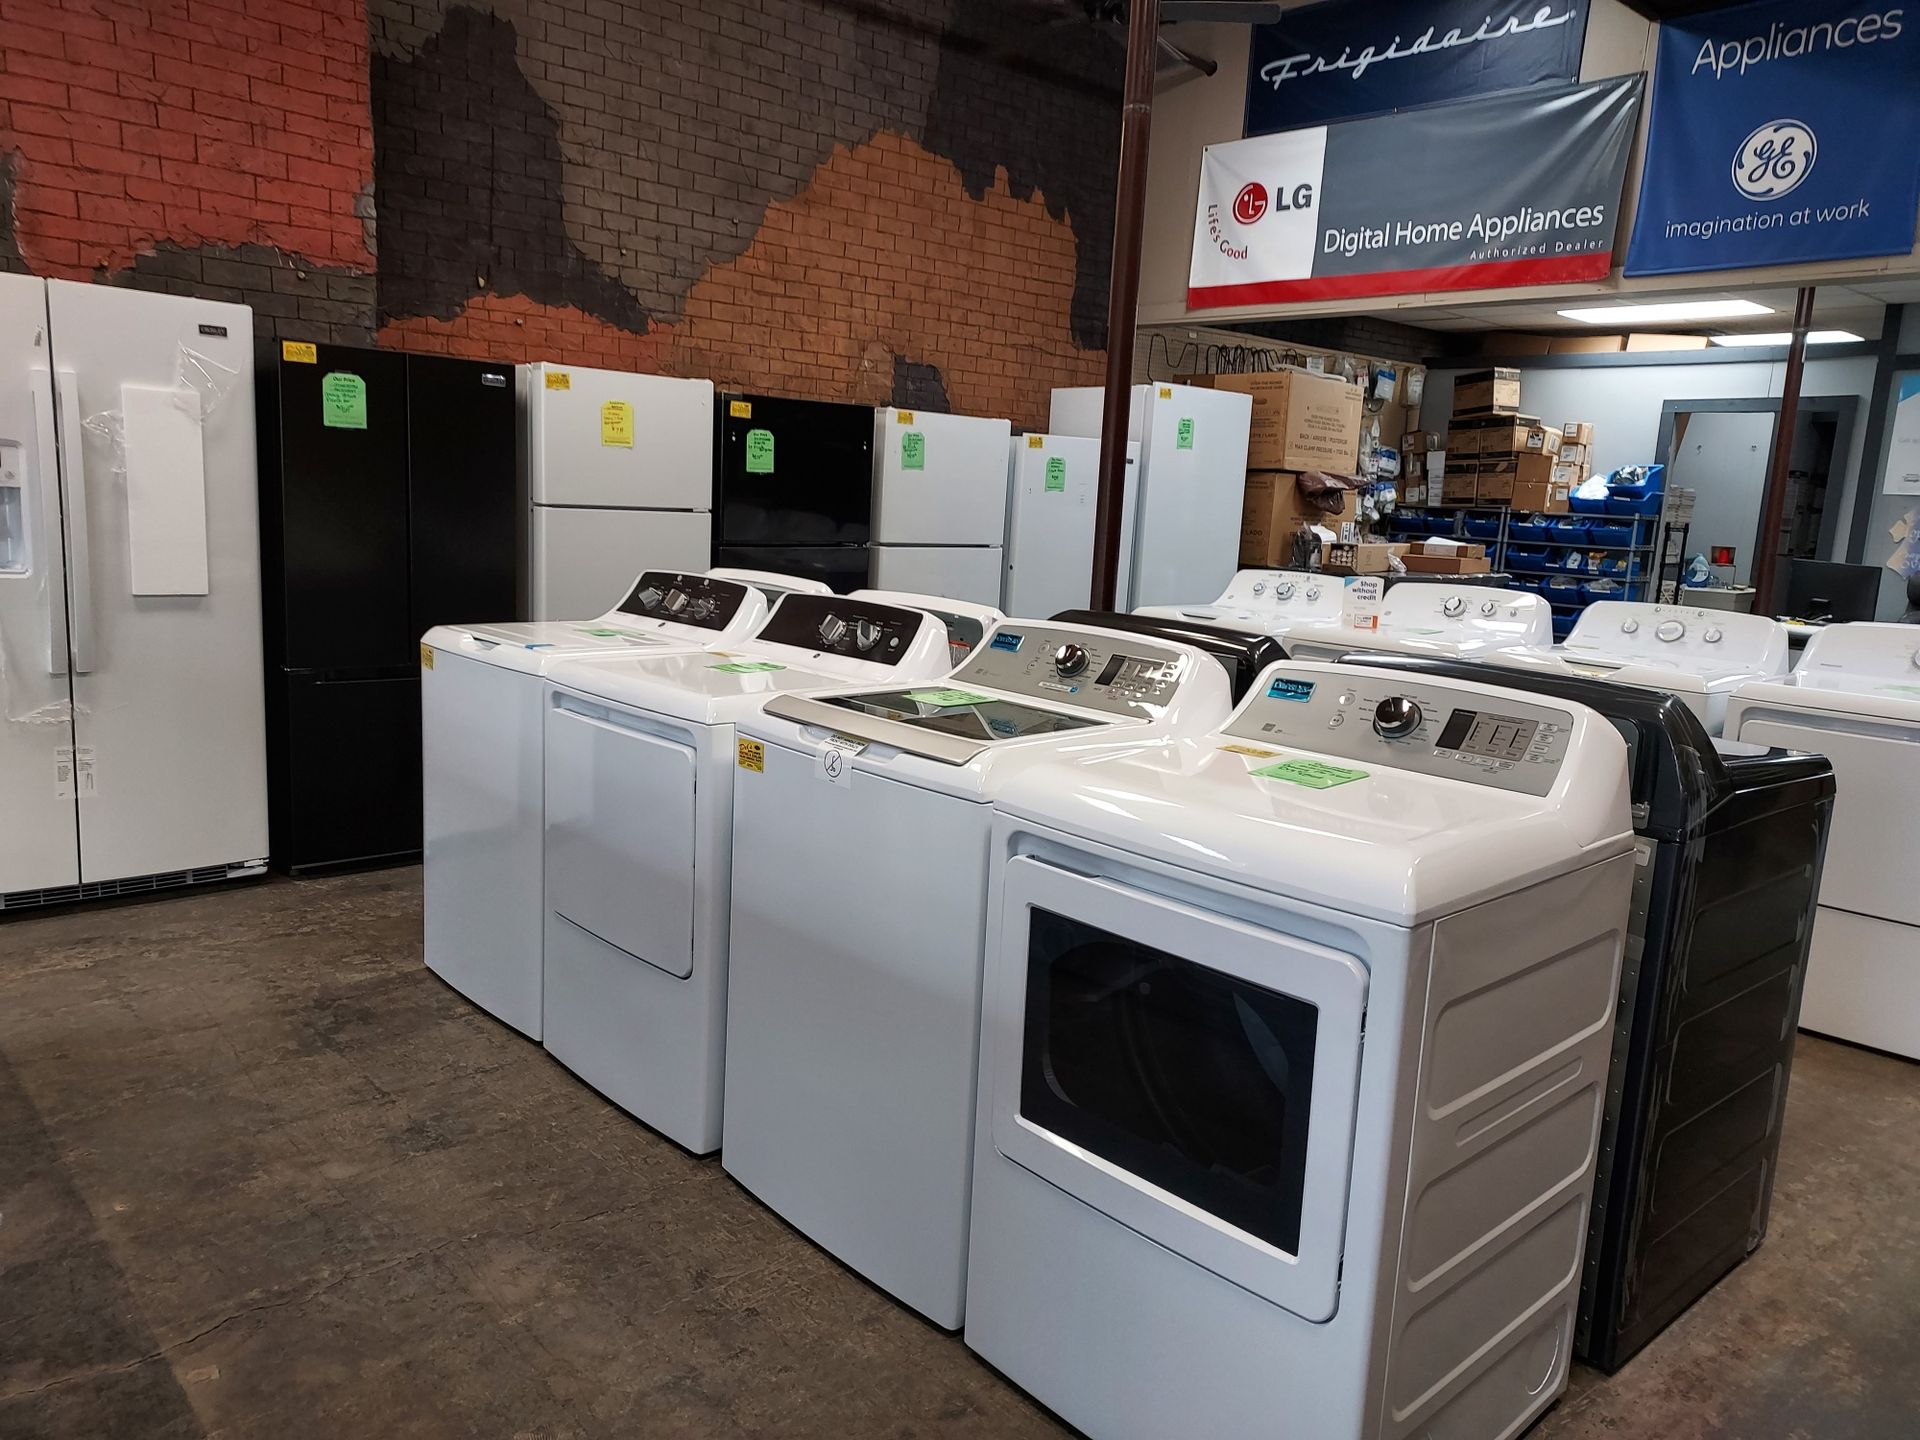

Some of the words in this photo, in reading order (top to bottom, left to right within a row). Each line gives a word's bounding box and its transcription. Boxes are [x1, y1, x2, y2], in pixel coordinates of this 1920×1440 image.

[1261, 5, 1570, 90] Frigidaire
[1691, 8, 1904, 80] Appliances
[1276, 183, 1313, 212] LG
[1665, 210, 1784, 240] imagination
[1789, 206, 1812, 227] at
[1816, 198, 1871, 223] work
[1207, 203, 1222, 243] Life's
[1219, 239, 1249, 260] Good
[1323, 221, 1391, 258] Digital
[1394, 220, 1463, 246] Home
[1465, 204, 1604, 244] Appliances
[1469, 242, 1547, 261] Authorized
[1554, 238, 1604, 254] Dealer
